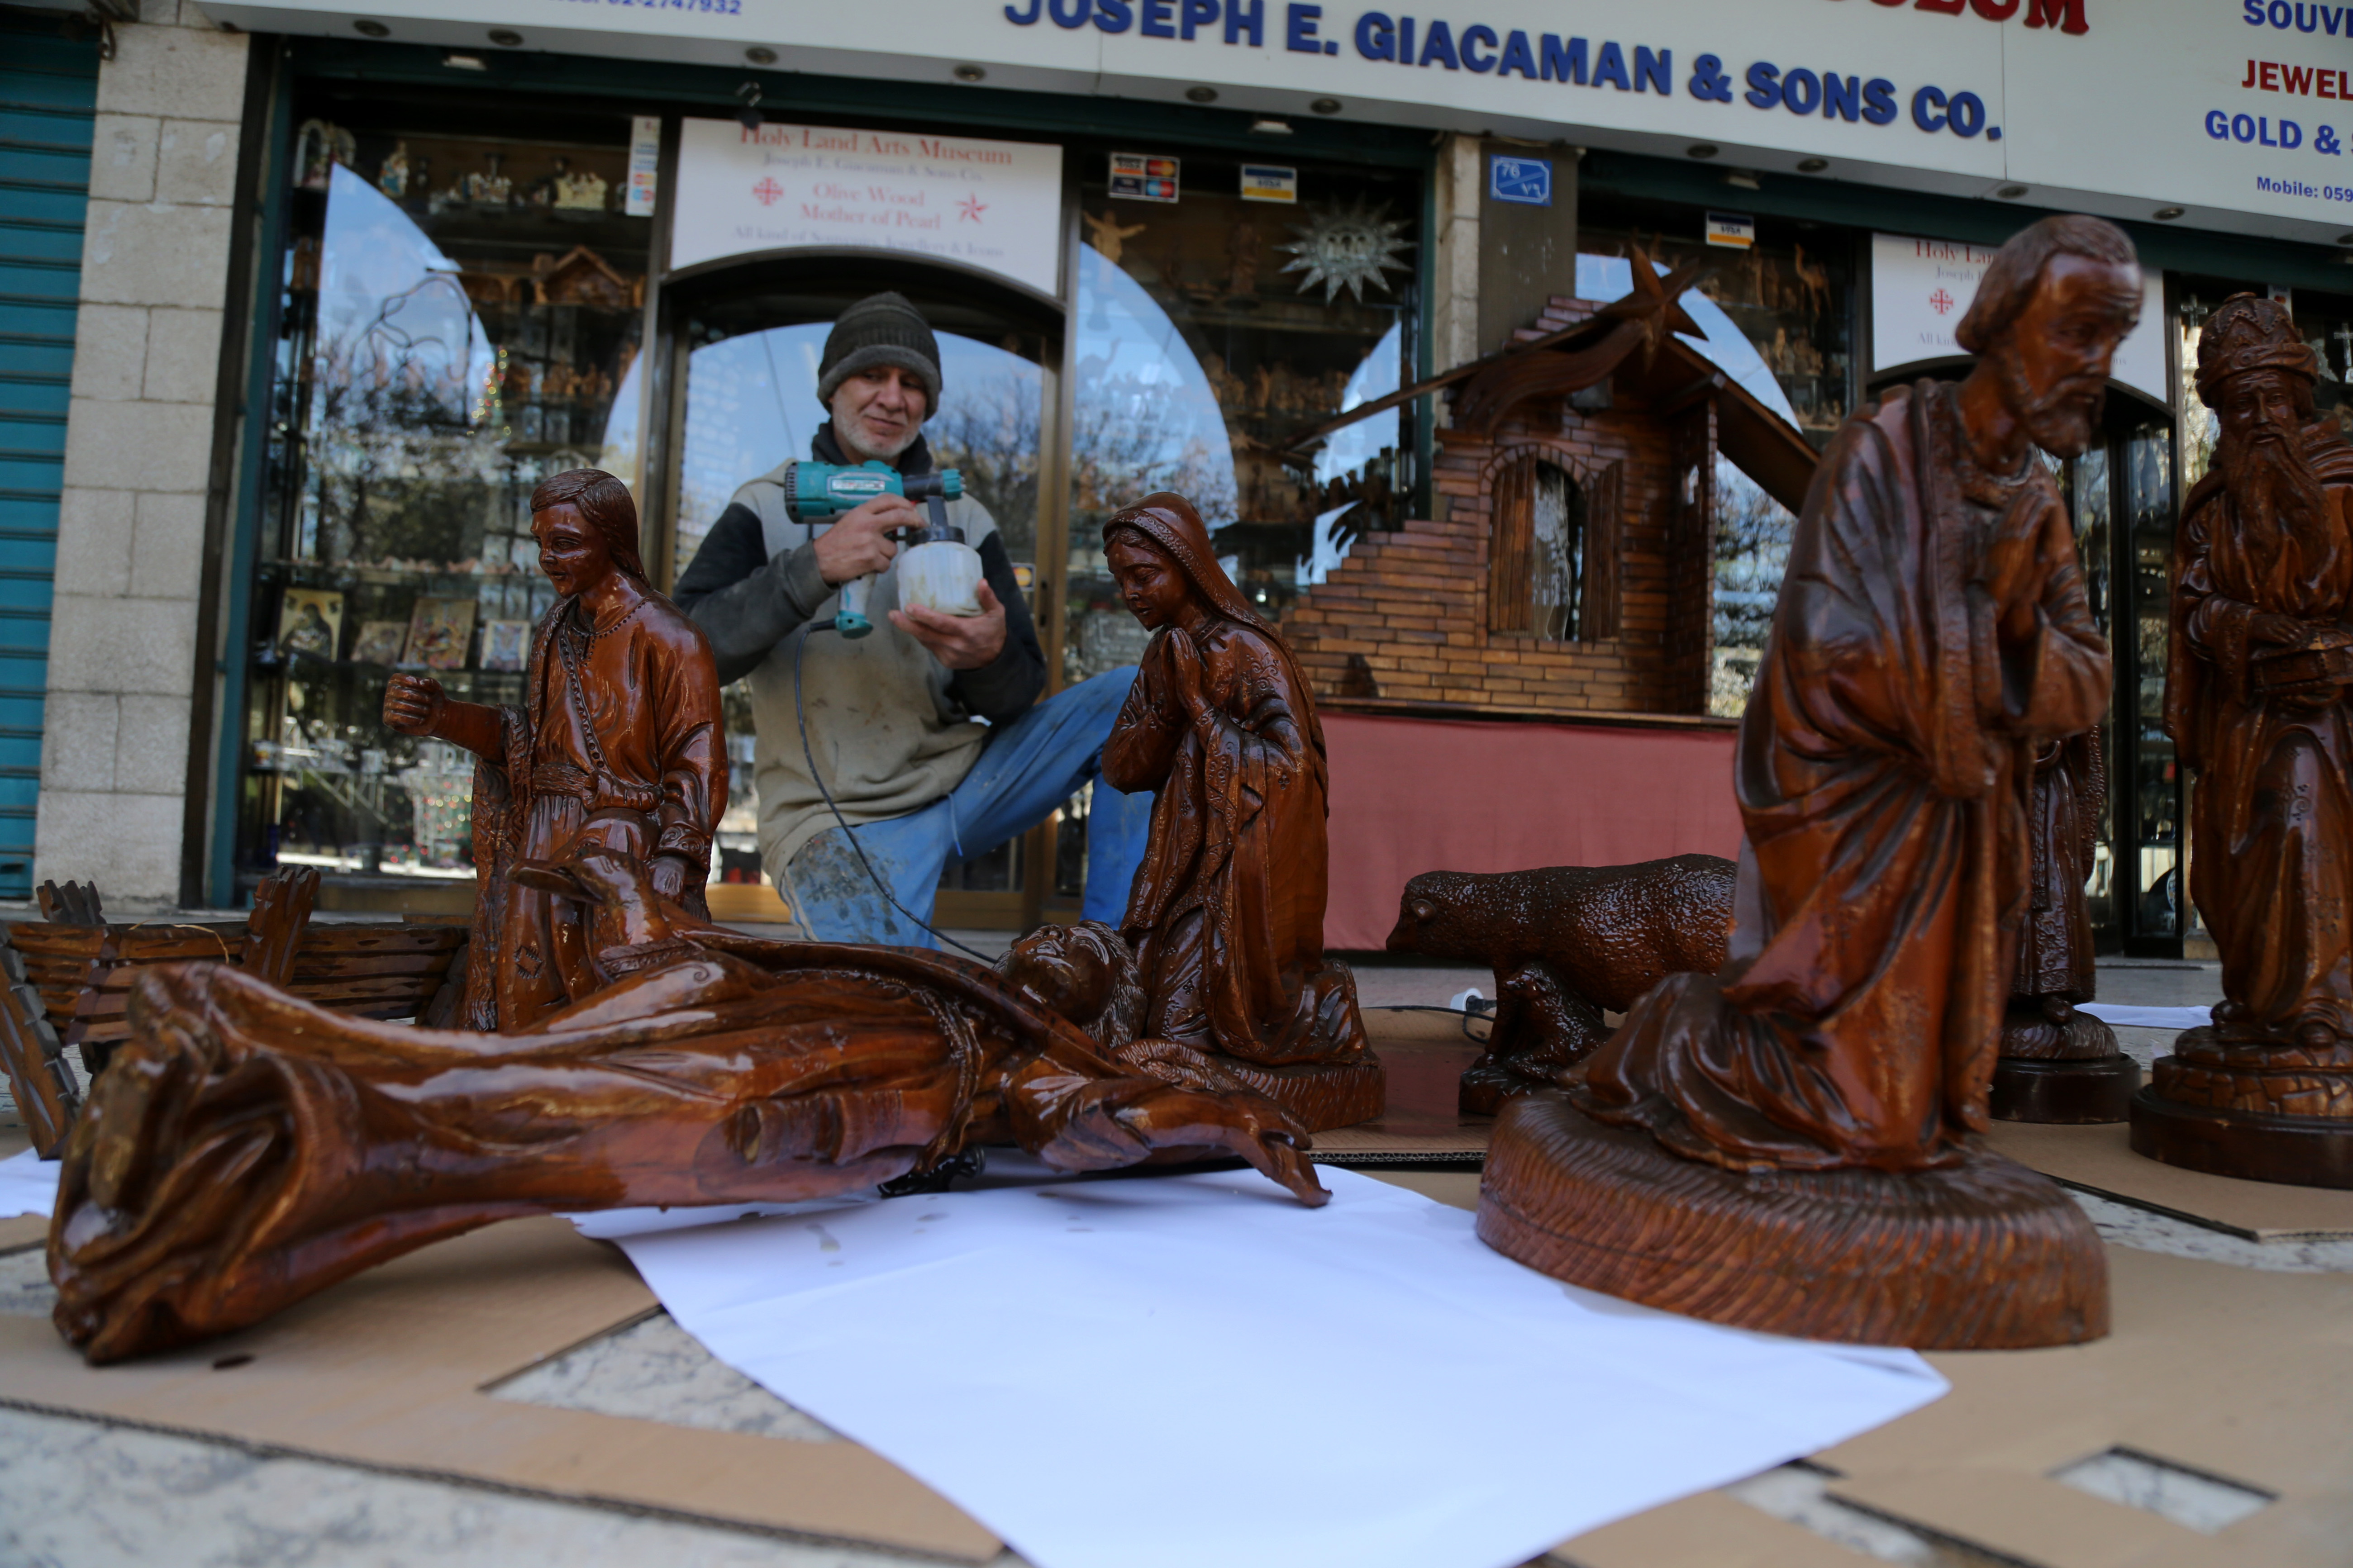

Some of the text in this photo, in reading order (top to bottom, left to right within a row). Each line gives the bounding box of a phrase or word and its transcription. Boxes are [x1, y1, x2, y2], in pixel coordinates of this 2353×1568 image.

[1005, 0, 2002, 141] JOSEPH E. GIACAMAN & SONS CO.
[2242, 59, 2353, 101] JEWEL
[740, 124, 1013, 165] Holy Land Arts Museum
[2205, 109, 2302, 150] GOLD
[2314, 124, 2341, 156] &
[1500, 162, 1520, 179] 76
[813, 181, 925, 207] Olive Wood
[2257, 176, 2353, 203] Mobile: 059
[800, 202, 866, 224] Mother
[895, 210, 941, 230] Pearl
[1916, 240, 1960, 266] Holy
